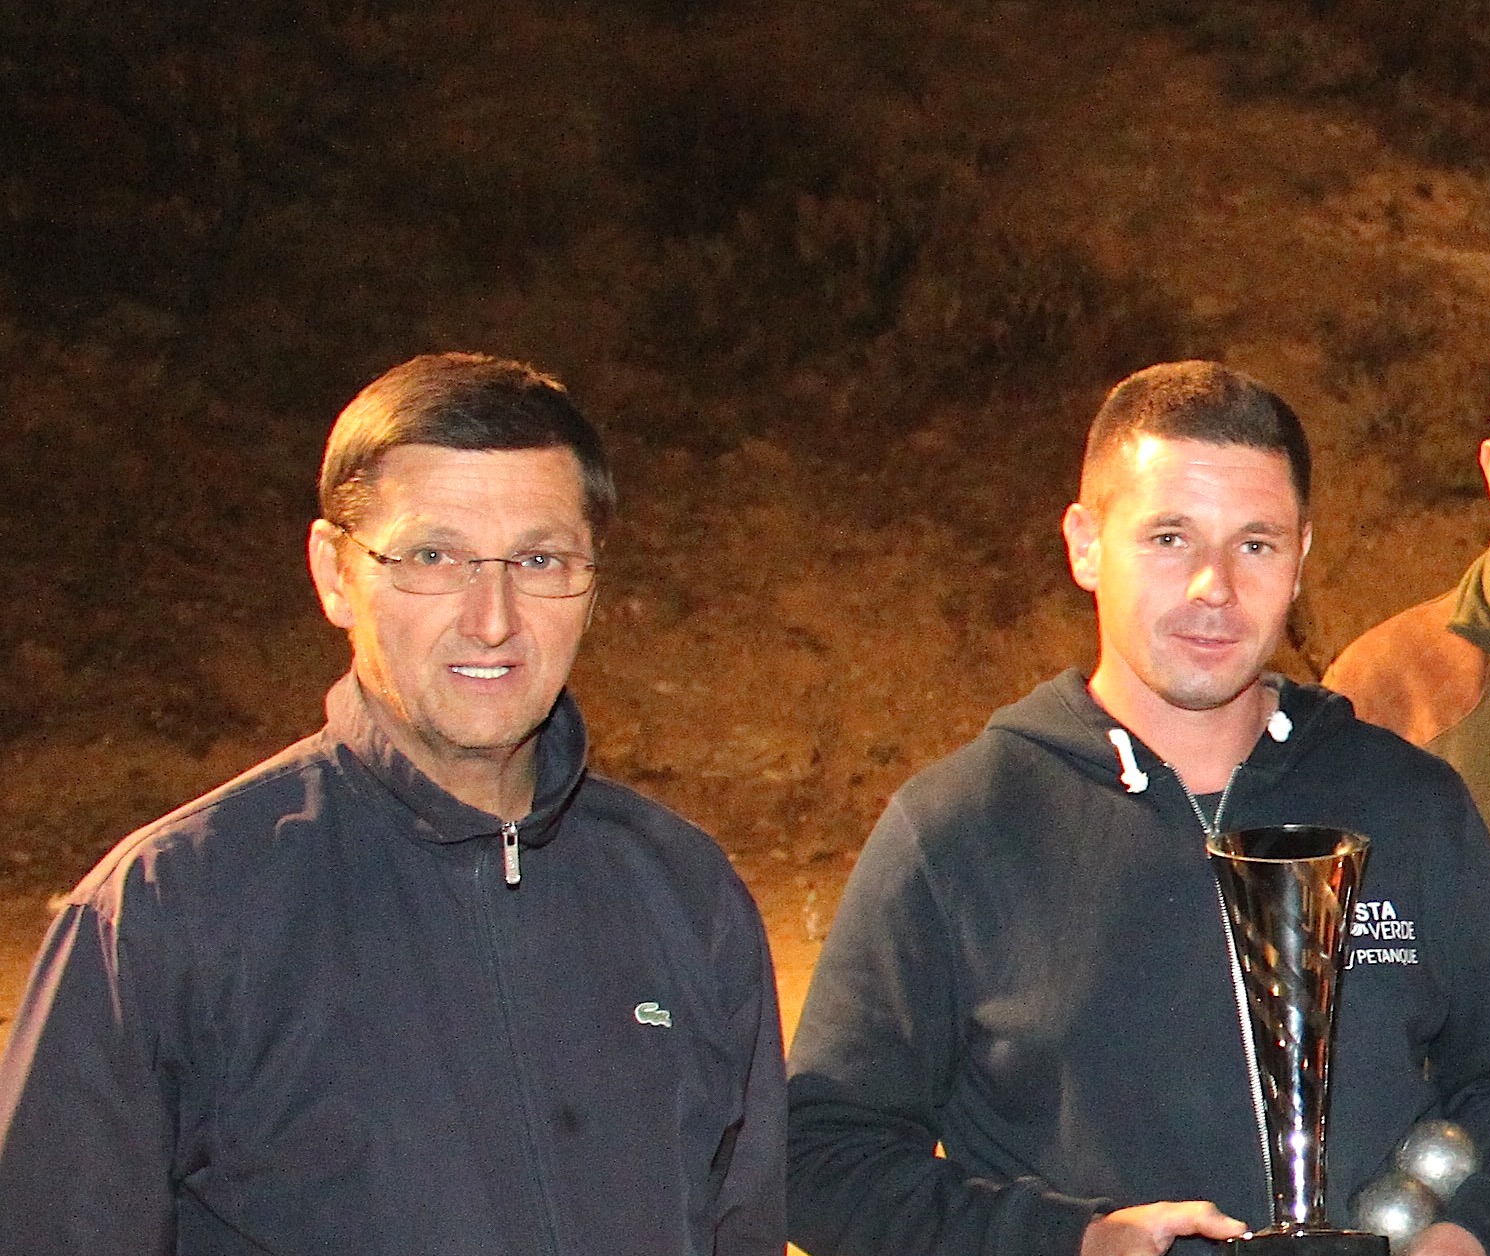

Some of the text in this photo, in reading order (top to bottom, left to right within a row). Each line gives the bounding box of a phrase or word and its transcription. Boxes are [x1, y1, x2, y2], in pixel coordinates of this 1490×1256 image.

[1355, 900, 1397, 922] STA
[1367, 920, 1416, 940] VERDE
[1356, 947, 1419, 966] PETANQUE
